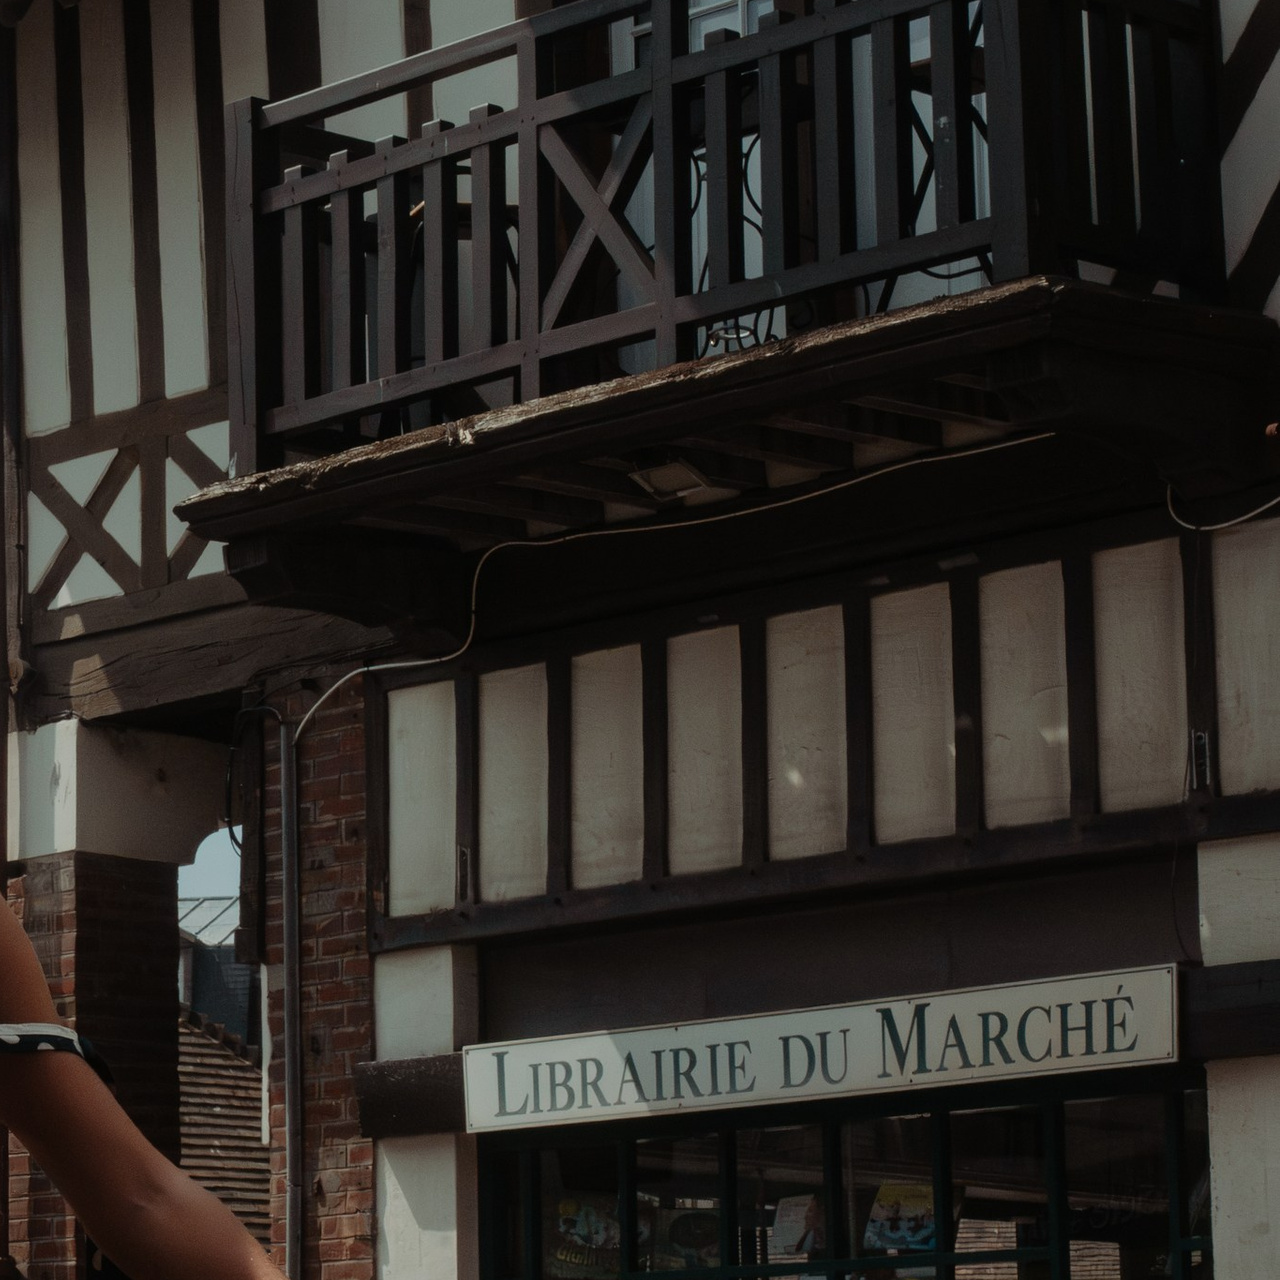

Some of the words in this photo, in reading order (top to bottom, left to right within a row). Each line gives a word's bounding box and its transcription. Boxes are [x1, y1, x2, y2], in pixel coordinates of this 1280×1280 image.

[491, 1039, 757, 1118] LIBRAIRIE
[780, 1028, 851, 1090] DU
[875, 984, 1138, 1079] MARCHÉ
